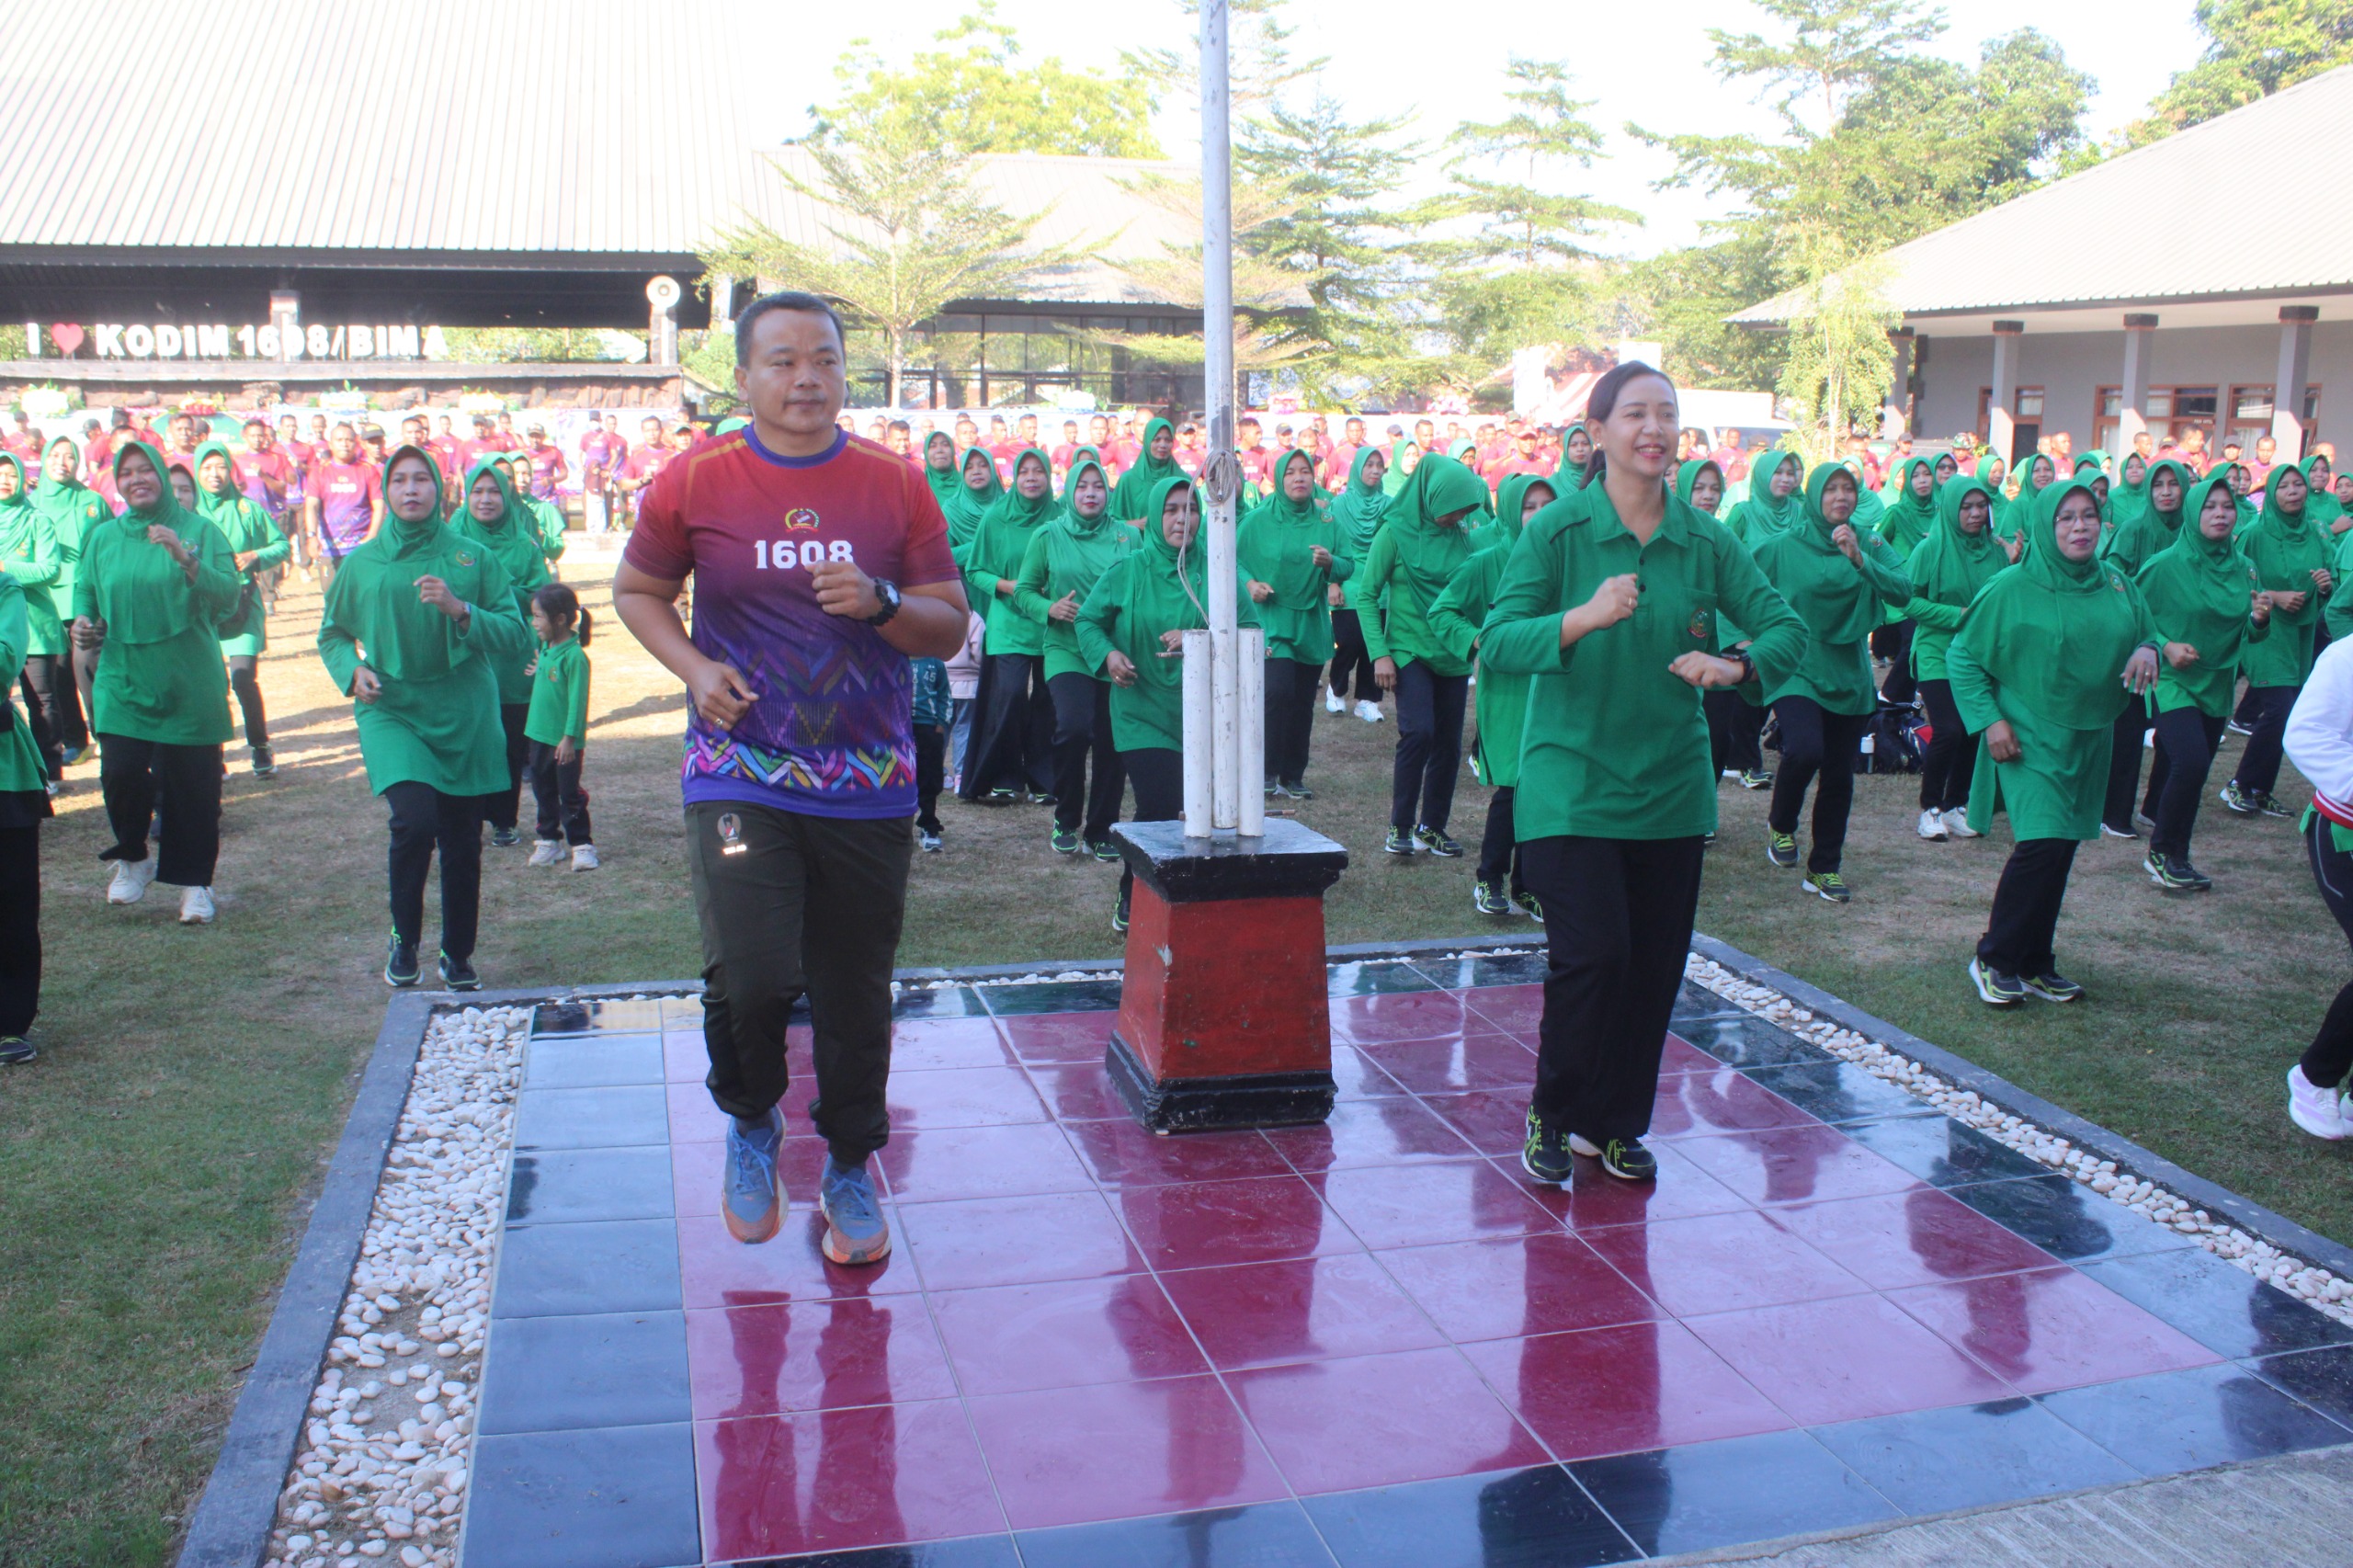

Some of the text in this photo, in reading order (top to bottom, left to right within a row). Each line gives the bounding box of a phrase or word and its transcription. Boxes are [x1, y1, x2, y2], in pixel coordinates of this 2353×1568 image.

[27, 323, 449, 357] I KODIM 1608/BIMA
[755, 540, 854, 569] 1608
[923, 670, 937, 683] 45
